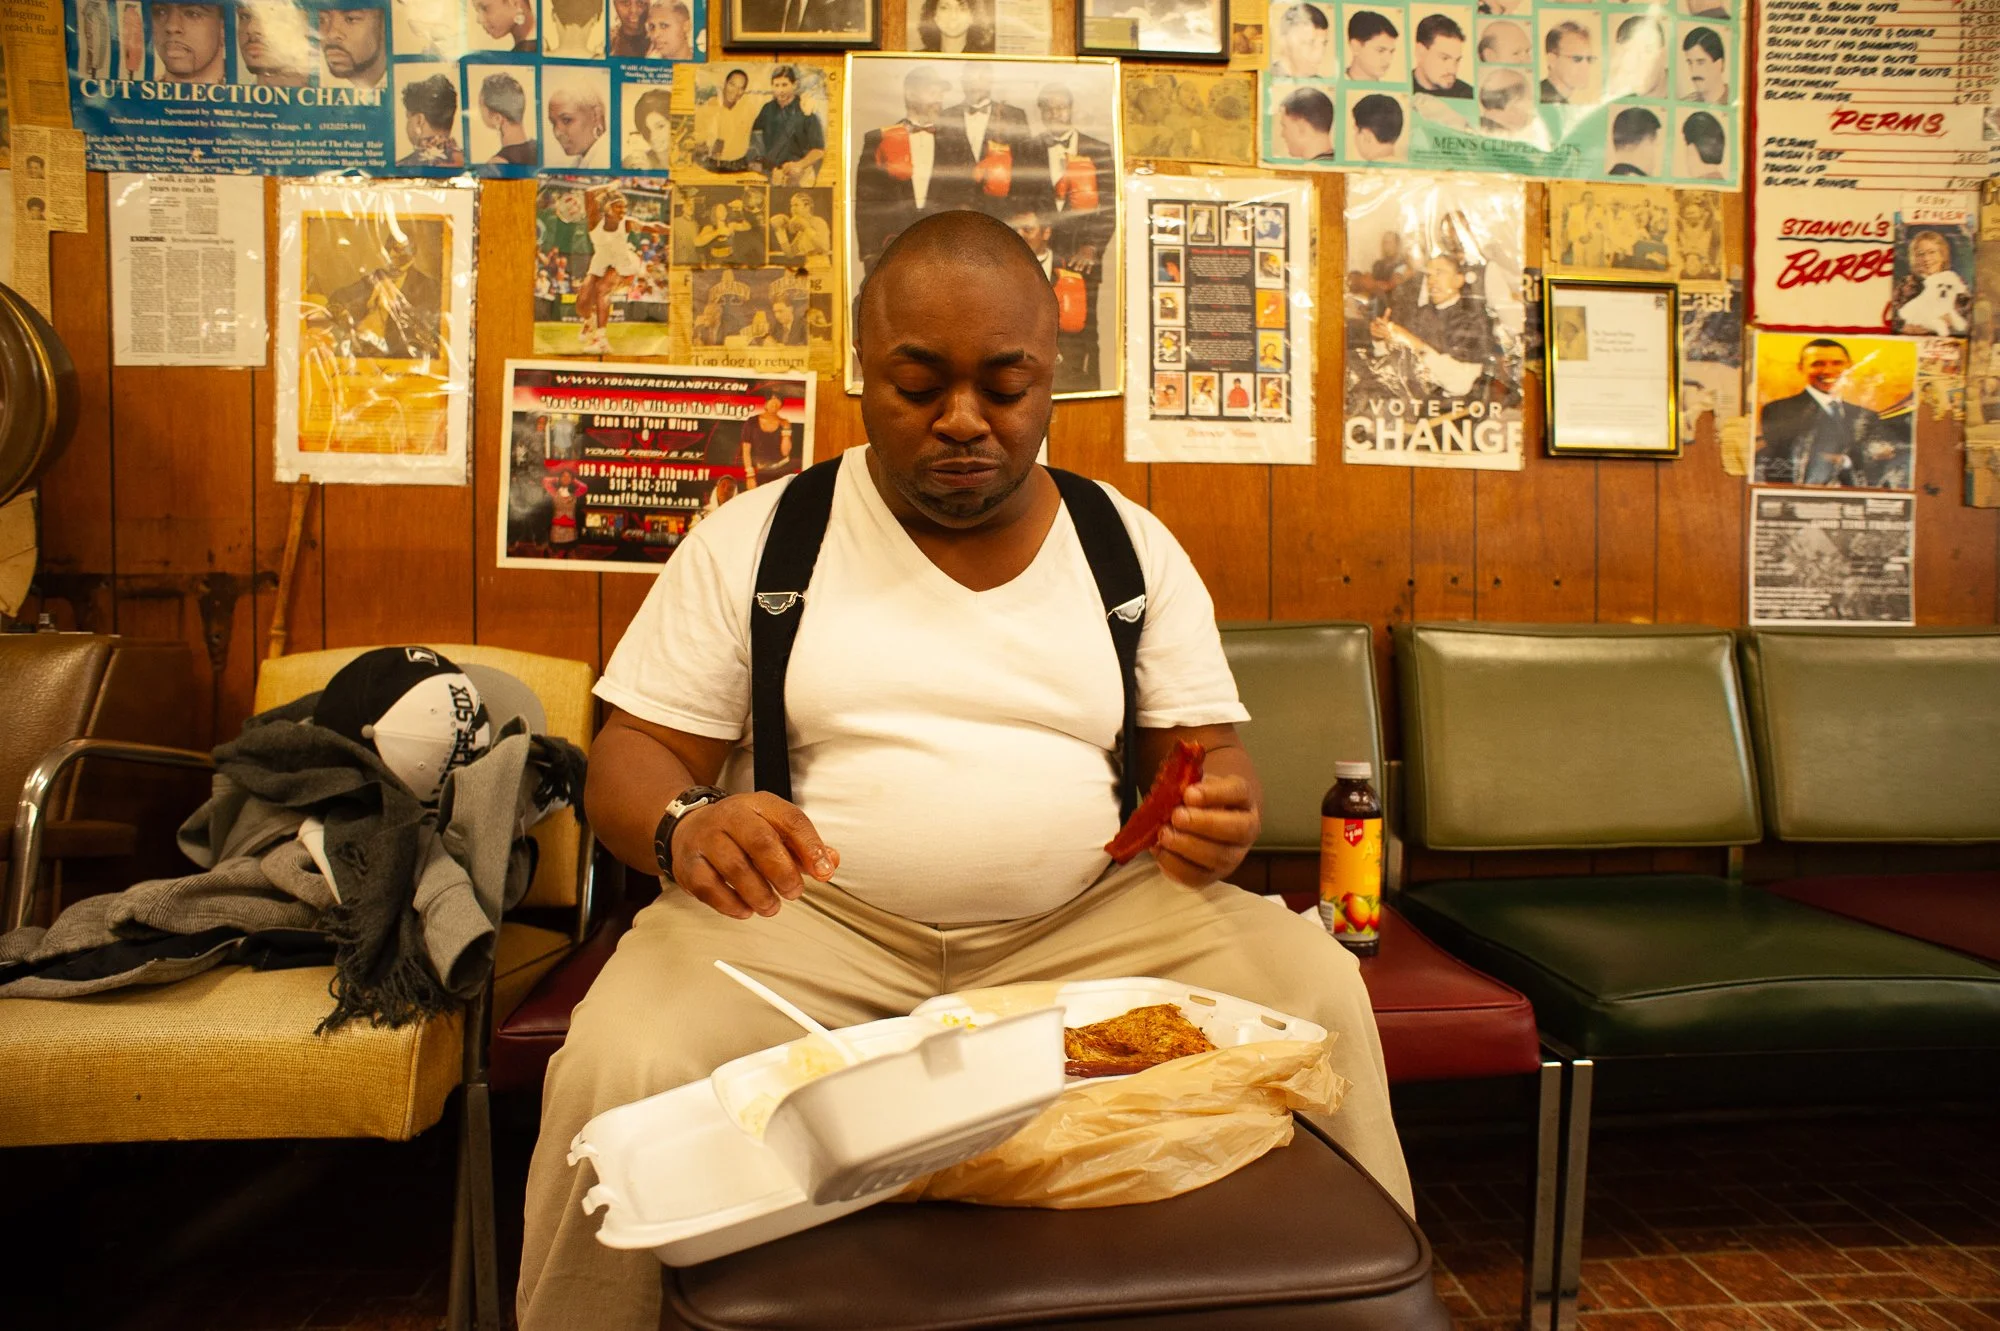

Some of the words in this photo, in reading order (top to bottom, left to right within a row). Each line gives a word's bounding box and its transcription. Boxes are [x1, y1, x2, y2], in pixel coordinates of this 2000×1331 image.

[1766, 1, 1823, 11] NATURAL
[1827, 1, 1862, 12] BLOW
[1866, 2, 1899, 13] OUTS
[1767, 13, 1806, 22] SUPER
[1809, 14, 1841, 23] BLOW
[1843, 15, 1877, 25] OUTS
[1767, 25, 1811, 34] SUPER
[1815, 26, 1848, 35] BLOW
[1850, 27, 1882, 37] OUTS
[1896, 28, 1936, 38] CURLS
[1766, 37, 1803, 48] BLOW
[1805, 39, 1831, 49] OUT
[1858, 40, 1918, 51] SHAMPOO)
[1842, 53, 1880, 63] BLOW
[1882, 54, 1918, 64] OUTS
[1833, 66, 1878, 76] SUPER
[1881, 66, 1916, 77] BLOW
[1918, 67, 1952, 78] OUTS
[1764, 77, 1839, 88] TREATMENT
[80, 79, 134, 99] CUT
[141, 81, 292, 105] SELECTION
[297, 87, 385, 107] CHART
[1764, 89, 1807, 101] BLACK
[1812, 91, 1852, 102] RINSE
[201, 108, 210, 116] by
[109, 116, 144, 125] Produced
[146, 118, 159, 126] and
[161, 119, 199, 127] Distributed
[200, 120, 208, 128] by
[1829, 107, 1946, 132] PERMS
[1432, 136, 1478, 150] MEN'S
[1480, 140, 1542, 154] CLIPPER
[1764, 137, 1818, 149] PERMS
[1762, 163, 1801, 173] TOUCH
[1805, 164, 1827, 174] UP
[1763, 176, 1808, 187] BLACK
[1813, 178, 1858, 189] RINSE
[1781, 213, 1890, 238] STANCIL'S
[722, 354, 745, 369] dog
[765, 356, 805, 369] return
[555, 375, 749, 392] WWW.YOUNGFRESHANDFLY.COM
[571, 397, 599, 411] Can't
[603, 398, 617, 411] Be
[622, 399, 639, 414] Fly
[643, 399, 687, 414] Without
[691, 401, 711, 414] The
[1369, 399, 1441, 417] VOTE
[1451, 401, 1502, 418] FOR
[593, 415, 615, 428] Come
[623, 416, 640, 428] Get
[643, 416, 665, 430] Your
[668, 417, 698, 431] Wings
[1345, 416, 1523, 453] CHANGE
[585, 448, 626, 457] YOUNG
[629, 449, 668, 457] FRESH
[680, 451, 705, 459] FLY
[586, 492, 700, 508] youngff@yahoo.com
[448, 683, 476, 722] SOX
